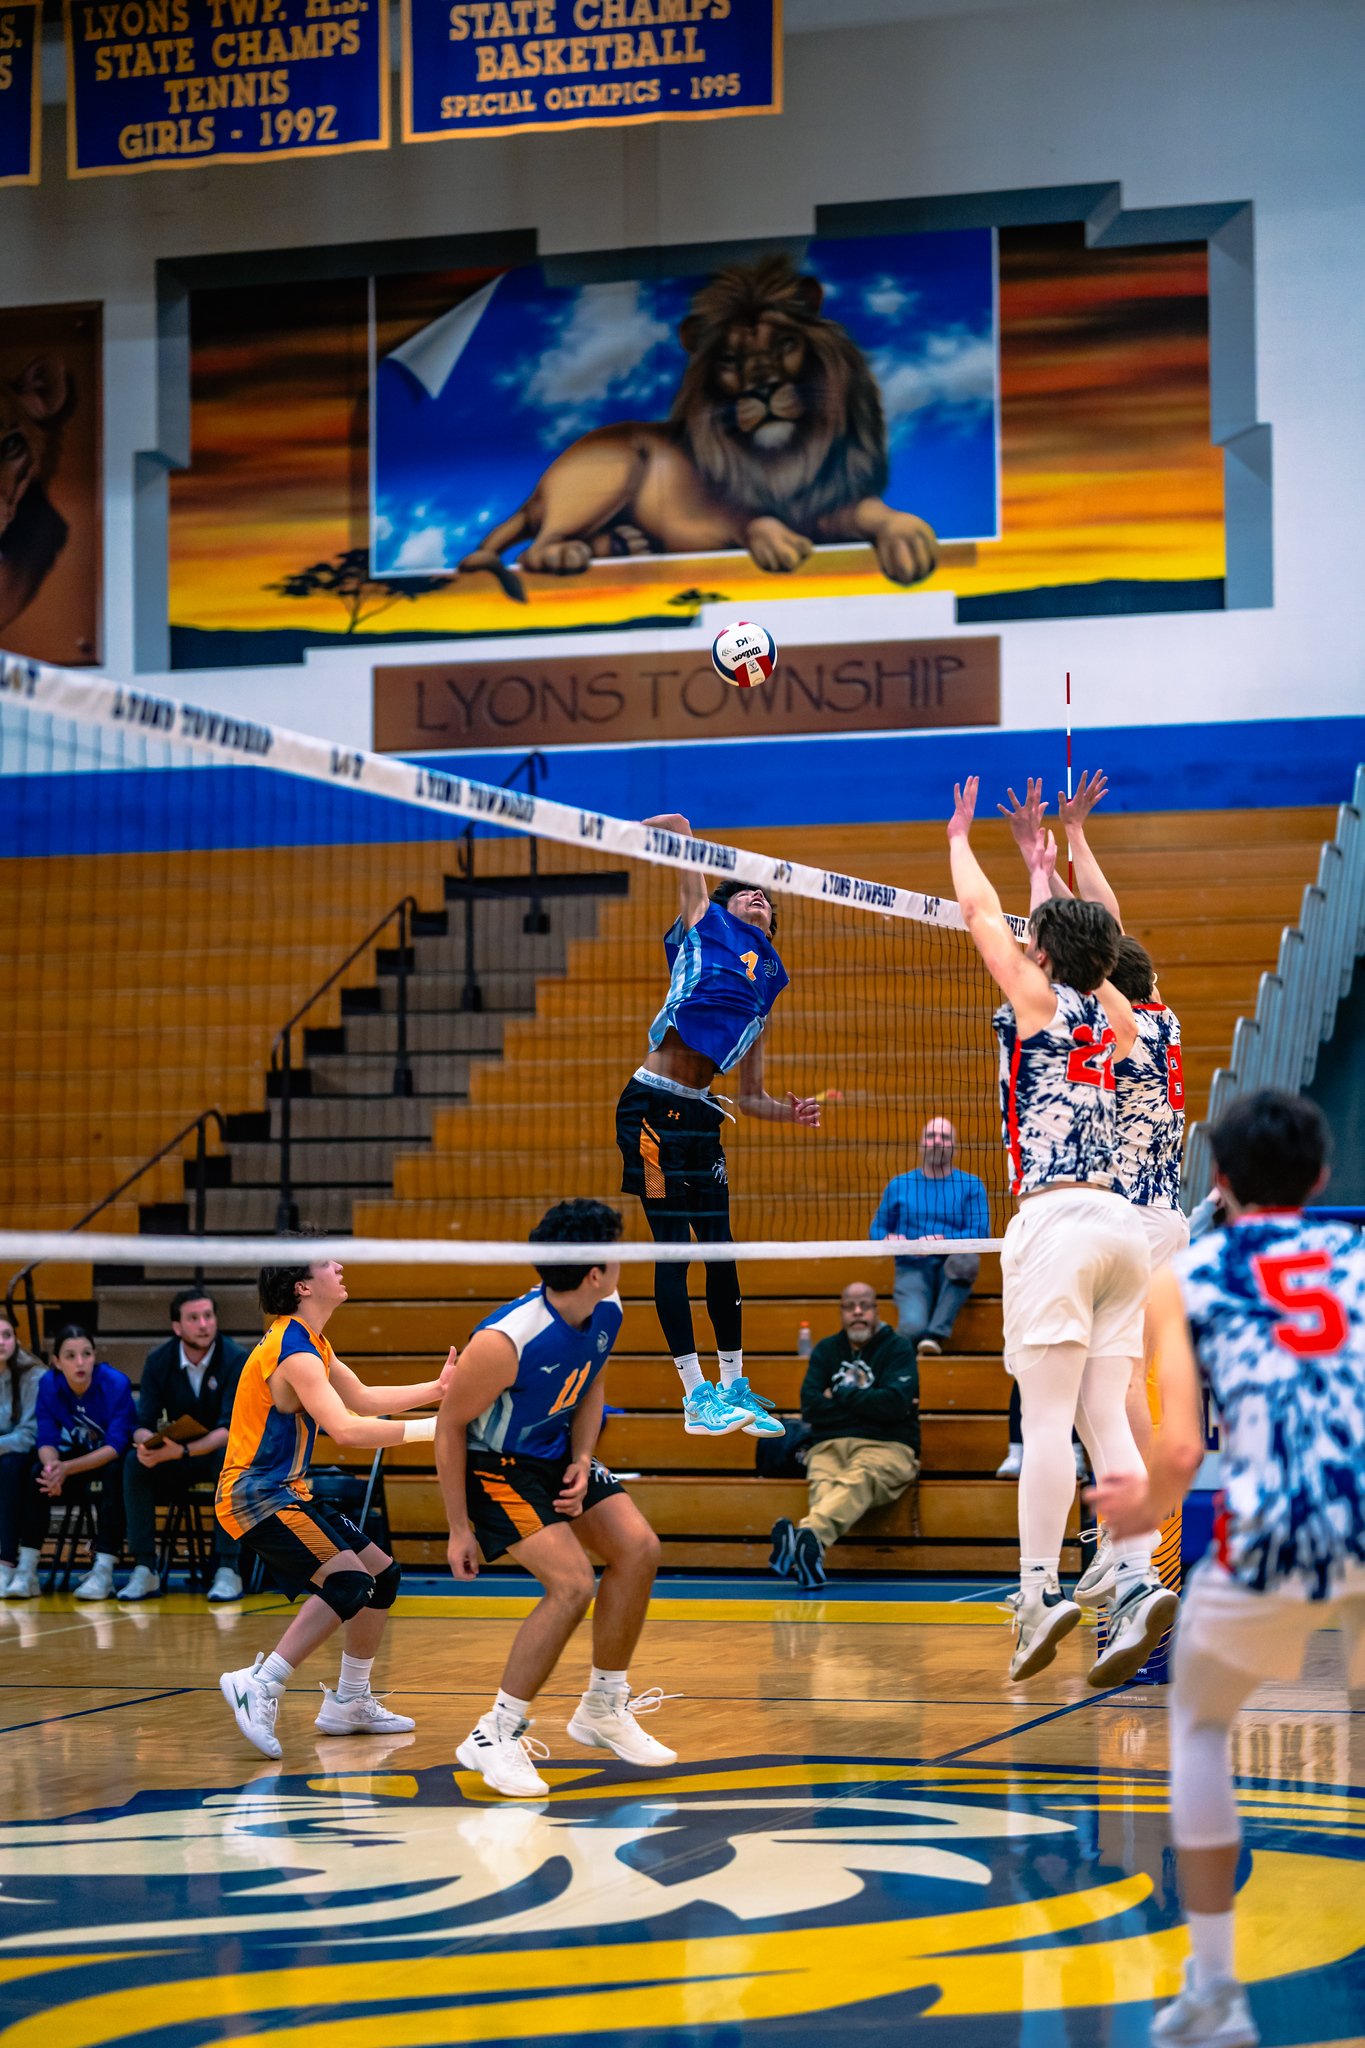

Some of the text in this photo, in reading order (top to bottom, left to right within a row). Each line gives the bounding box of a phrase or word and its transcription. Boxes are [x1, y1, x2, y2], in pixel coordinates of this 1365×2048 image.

[84, 1, 190, 42] LYONS
[207, 0, 286, 28] TWP.
[449, 0, 731, 40] STATE CHAMPS
[95, 19, 360, 81] STATE CHAMPS
[476, 27, 706, 82] BASKETBALL
[164, 70, 289, 114] TENNIS
[441, 90, 536, 119] SPECIAL
[545, 79, 661, 111] OLYMPICS
[690, 73, 741, 99] 1995
[118, 116, 215, 159] GIRLS
[259, 105, 338, 146] 1992
[731, 646, 762, 662] Wilson
[416, 655, 964, 731] LYONS TOWNSHIP
[1252, 1250, 1349, 1358] 5
[548, 1360, 592, 1417] 11
